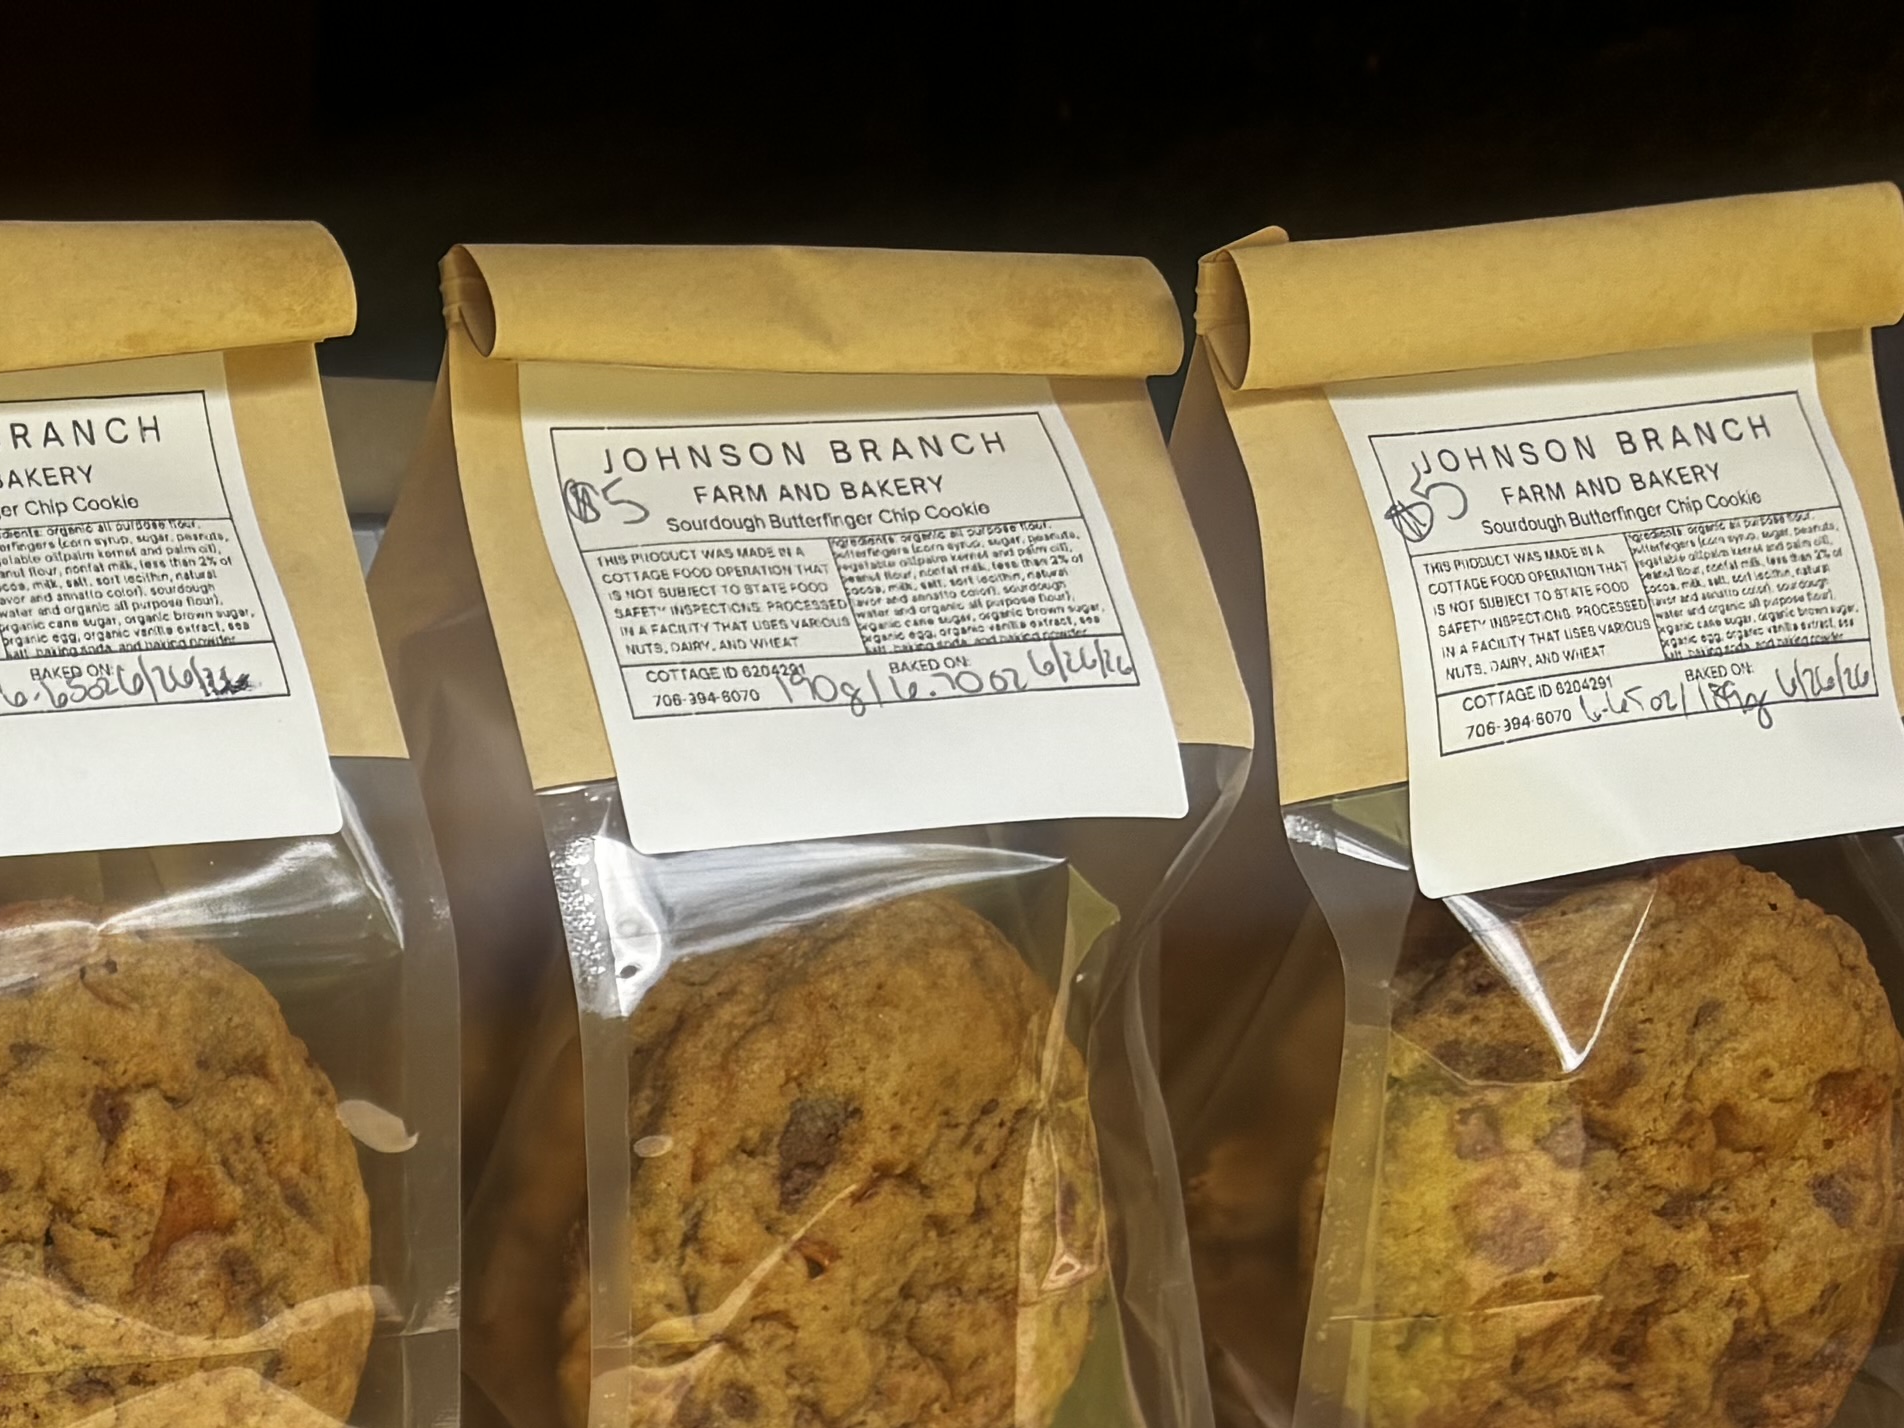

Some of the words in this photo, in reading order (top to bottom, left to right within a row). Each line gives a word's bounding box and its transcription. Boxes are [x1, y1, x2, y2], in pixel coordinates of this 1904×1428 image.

[602, 439, 807, 475] JOHNSON
[828, 430, 1007, 465] BRANCH
[1419, 433, 1597, 476] JOHNSON
[1614, 413, 1772, 456] BRANCH
[23, 497, 70, 518] Chip
[71, 493, 140, 513] Cookie
[692, 482, 769, 506] FARM
[778, 481, 832, 503] AND
[838, 473, 944, 501] BAKERY
[1499, 480, 1567, 507] FARM
[1574, 474, 1623, 500] AND
[1628, 461, 1720, 492] BAKERY
[665, 513, 767, 534] Sourdough
[767, 511, 874, 530] Butterfinger
[877, 506, 922, 525] Chip
[923, 500, 991, 521] Cookie
[1480, 513, 1568, 536] Sourdough
[1566, 503, 1663, 528] Butterfinger
[1665, 495, 1704, 516] Chip
[1704, 488, 1763, 510] Cookie
